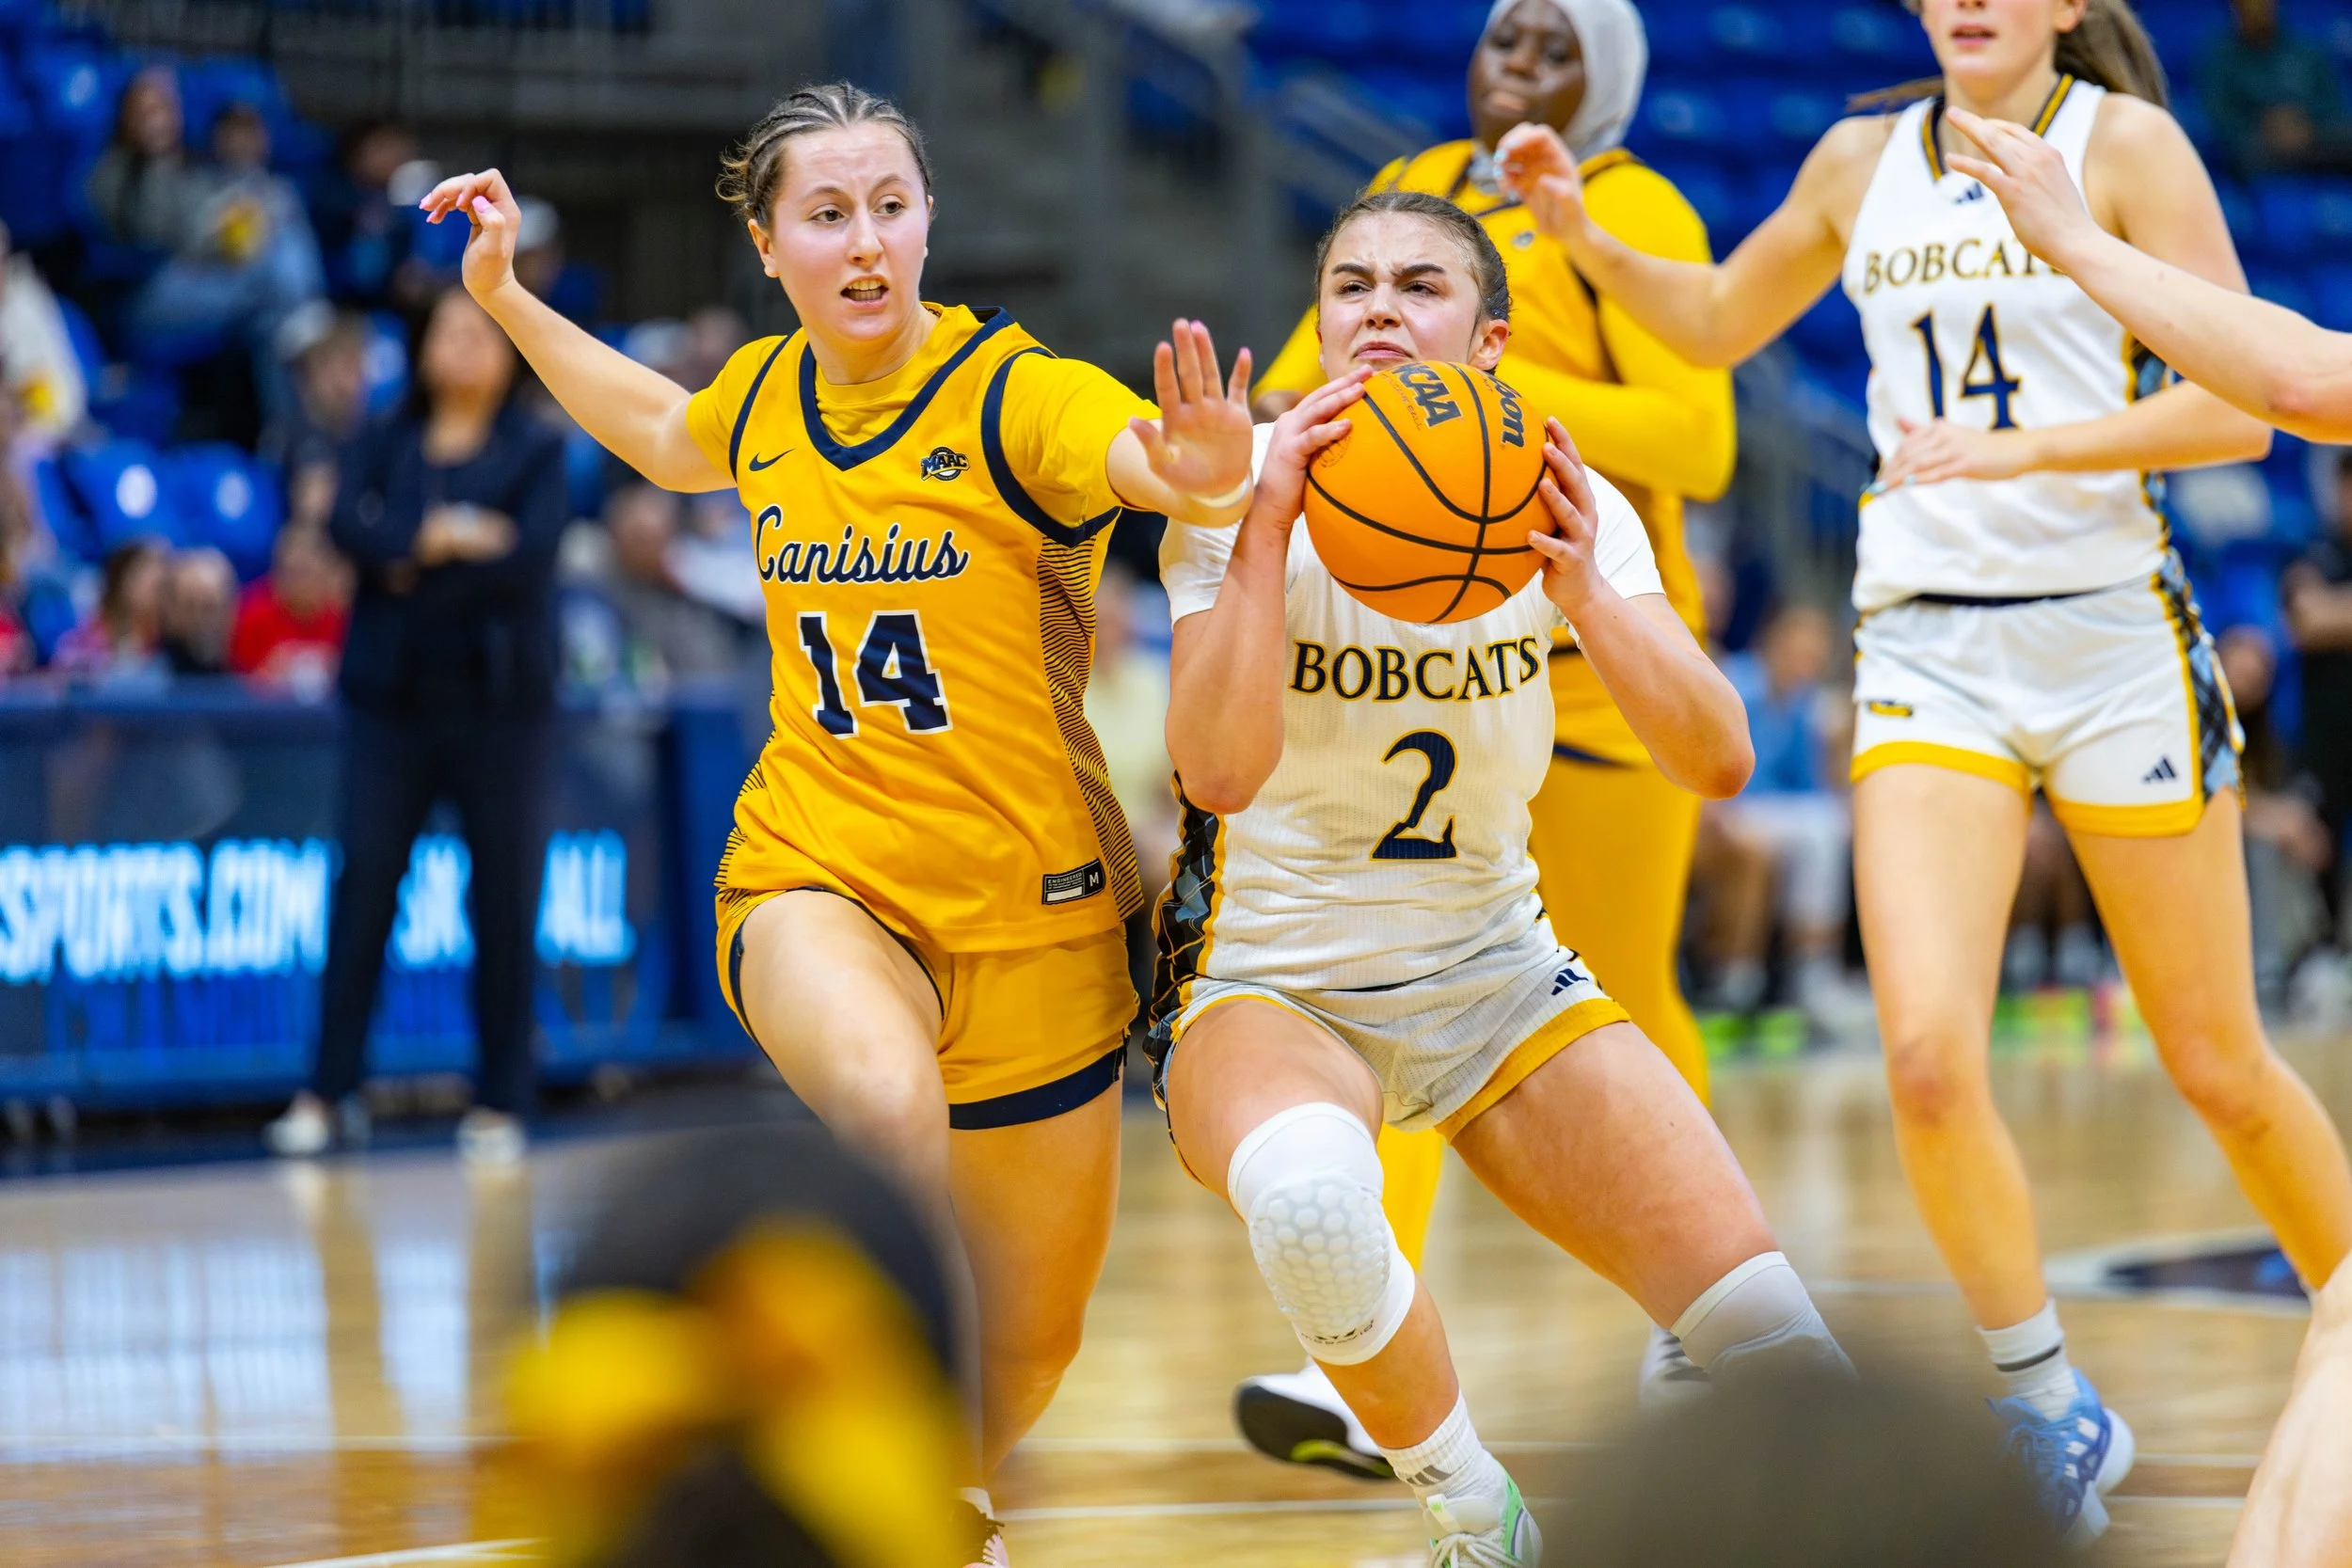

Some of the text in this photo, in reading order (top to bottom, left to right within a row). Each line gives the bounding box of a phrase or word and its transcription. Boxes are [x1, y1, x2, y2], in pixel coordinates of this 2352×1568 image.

[1863, 237, 2067, 294] BOBCAT
[1391, 362, 1463, 428] NCAA
[1909, 302, 2021, 432] 14
[921, 453, 969, 478] MAAC
[755, 504, 970, 585] Canisius
[797, 609, 953, 740] 14
[1288, 635, 1542, 704] BOBCATS
[1369, 728, 1459, 862] 2
[1089, 871, 1100, 887] M
